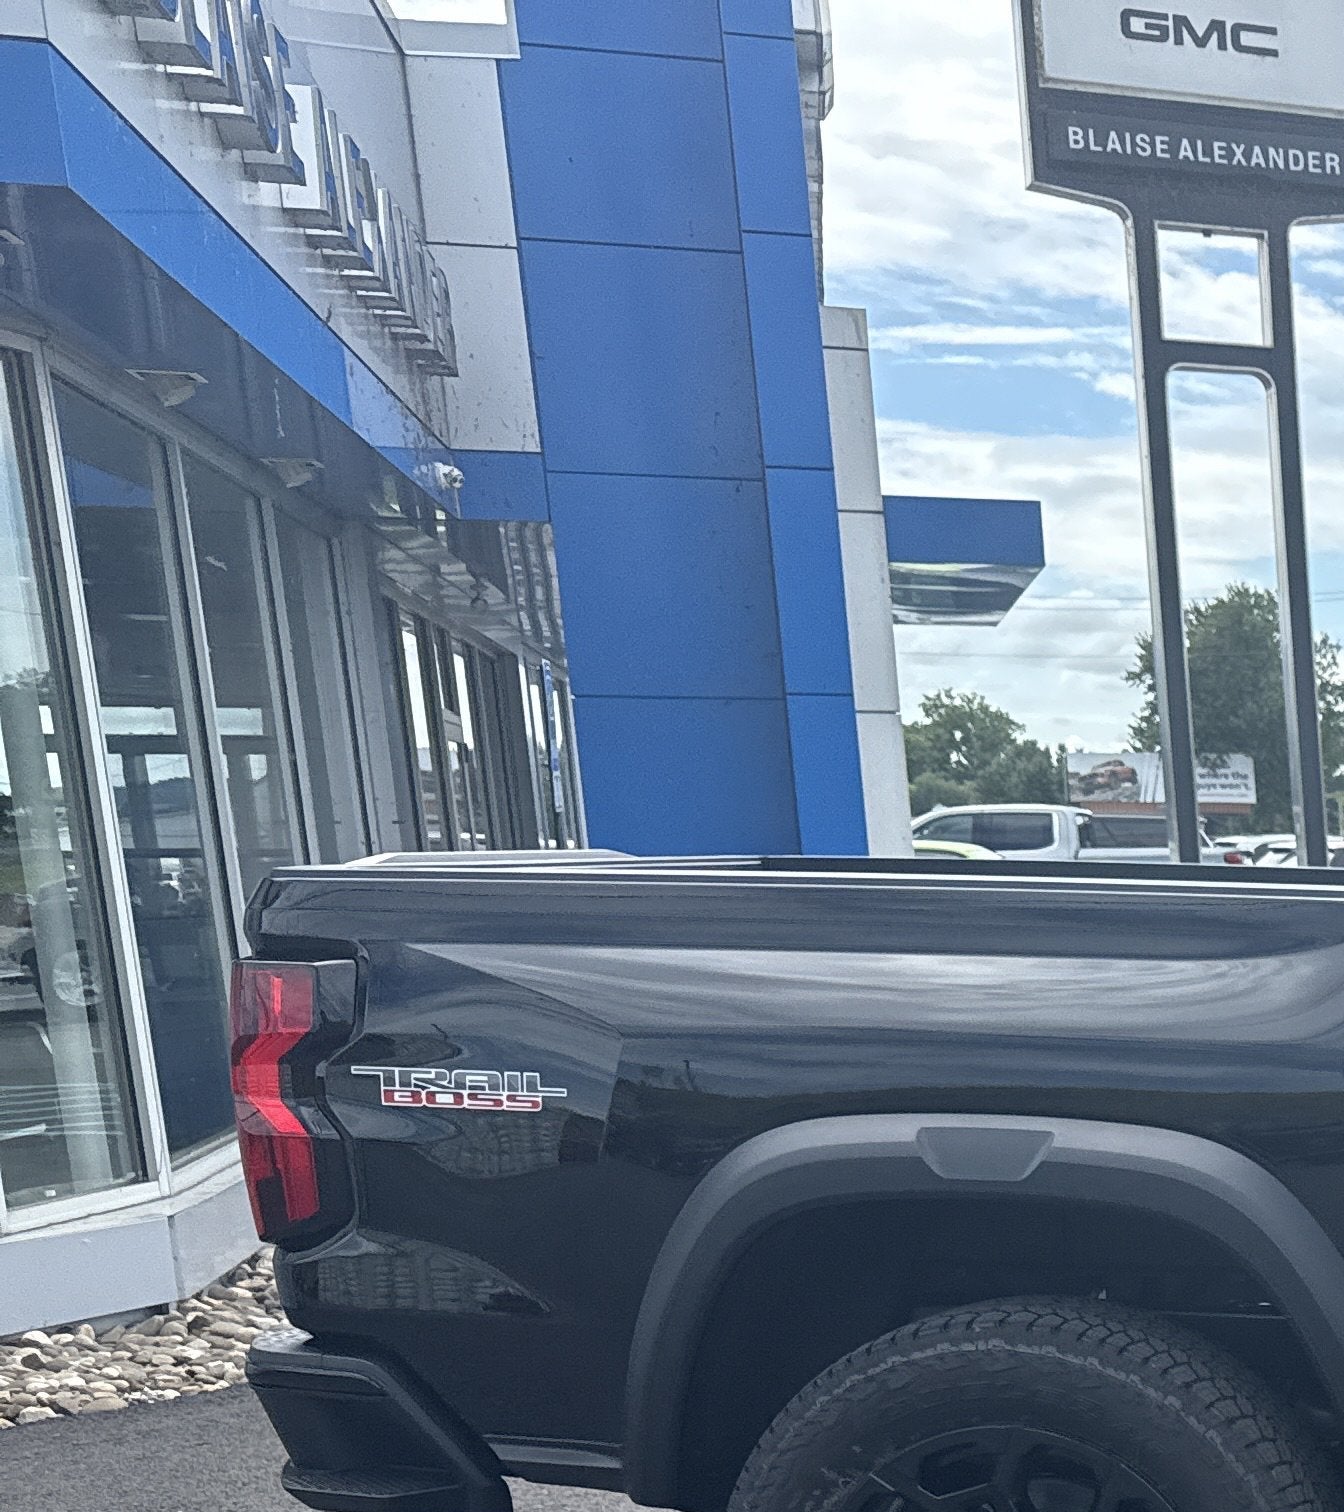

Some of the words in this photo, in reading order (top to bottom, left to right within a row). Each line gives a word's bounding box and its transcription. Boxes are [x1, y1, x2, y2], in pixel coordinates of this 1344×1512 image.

[1120, 8, 1279, 58] GMC
[1067, 126, 1170, 159] BLAISE
[1179, 138, 1341, 175] ALEXANDER
[351, 1066, 567, 1097] TRAIL
[381, 1087, 543, 1112] BOSS
